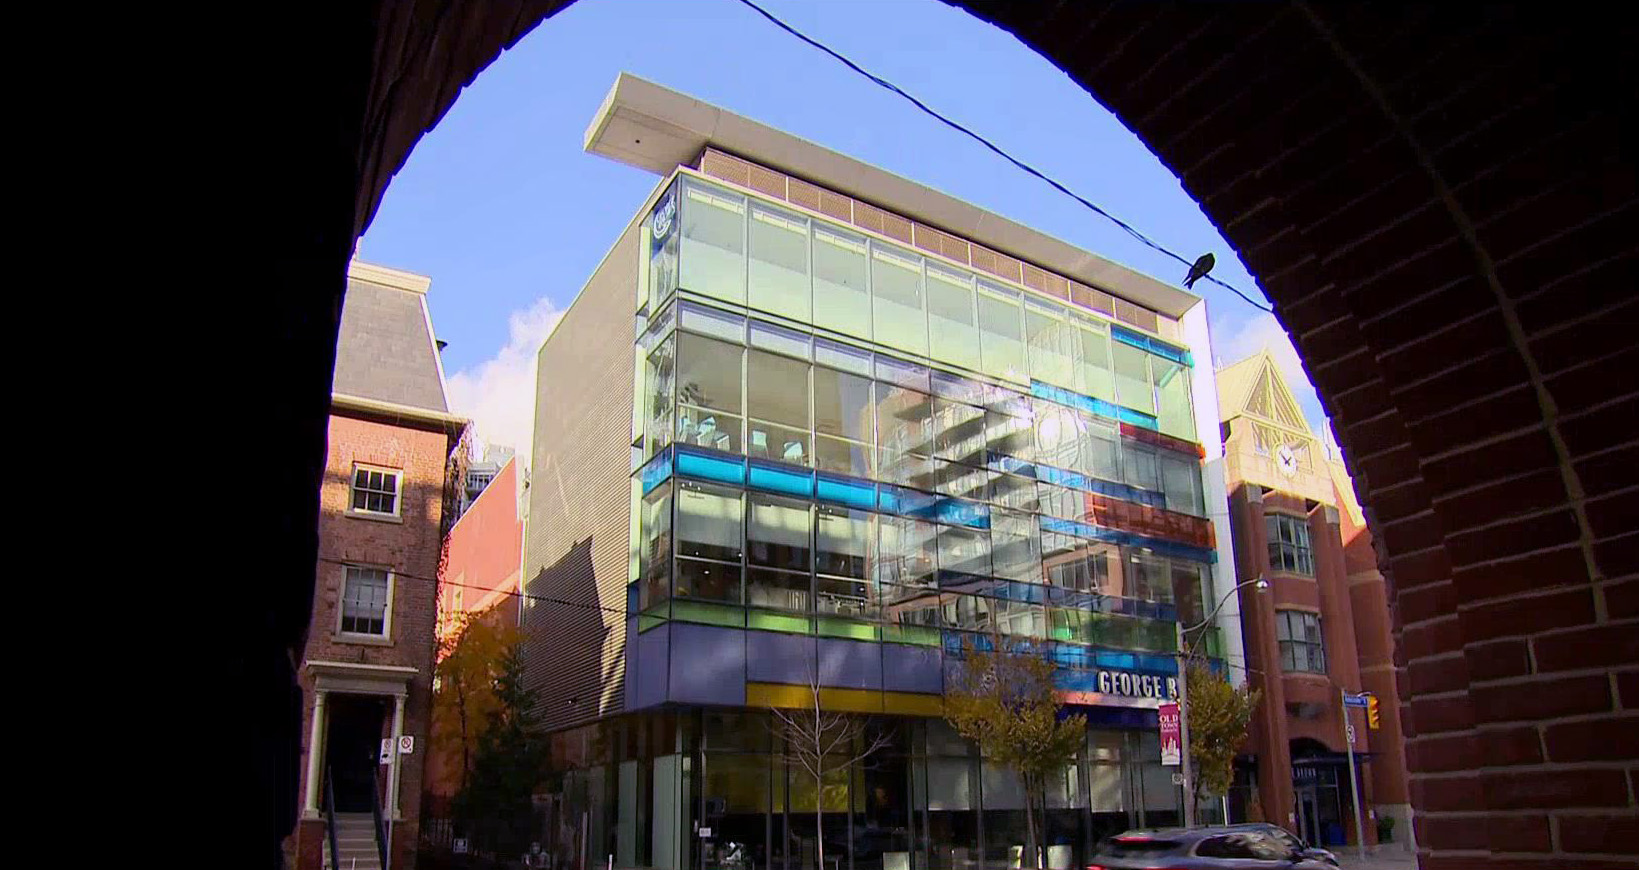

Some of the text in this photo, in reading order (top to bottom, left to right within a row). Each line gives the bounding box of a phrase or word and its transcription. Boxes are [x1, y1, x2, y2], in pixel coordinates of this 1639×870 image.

[1098, 671, 1178, 699] GEORGE B
[1160, 714, 1178, 723] OLD
